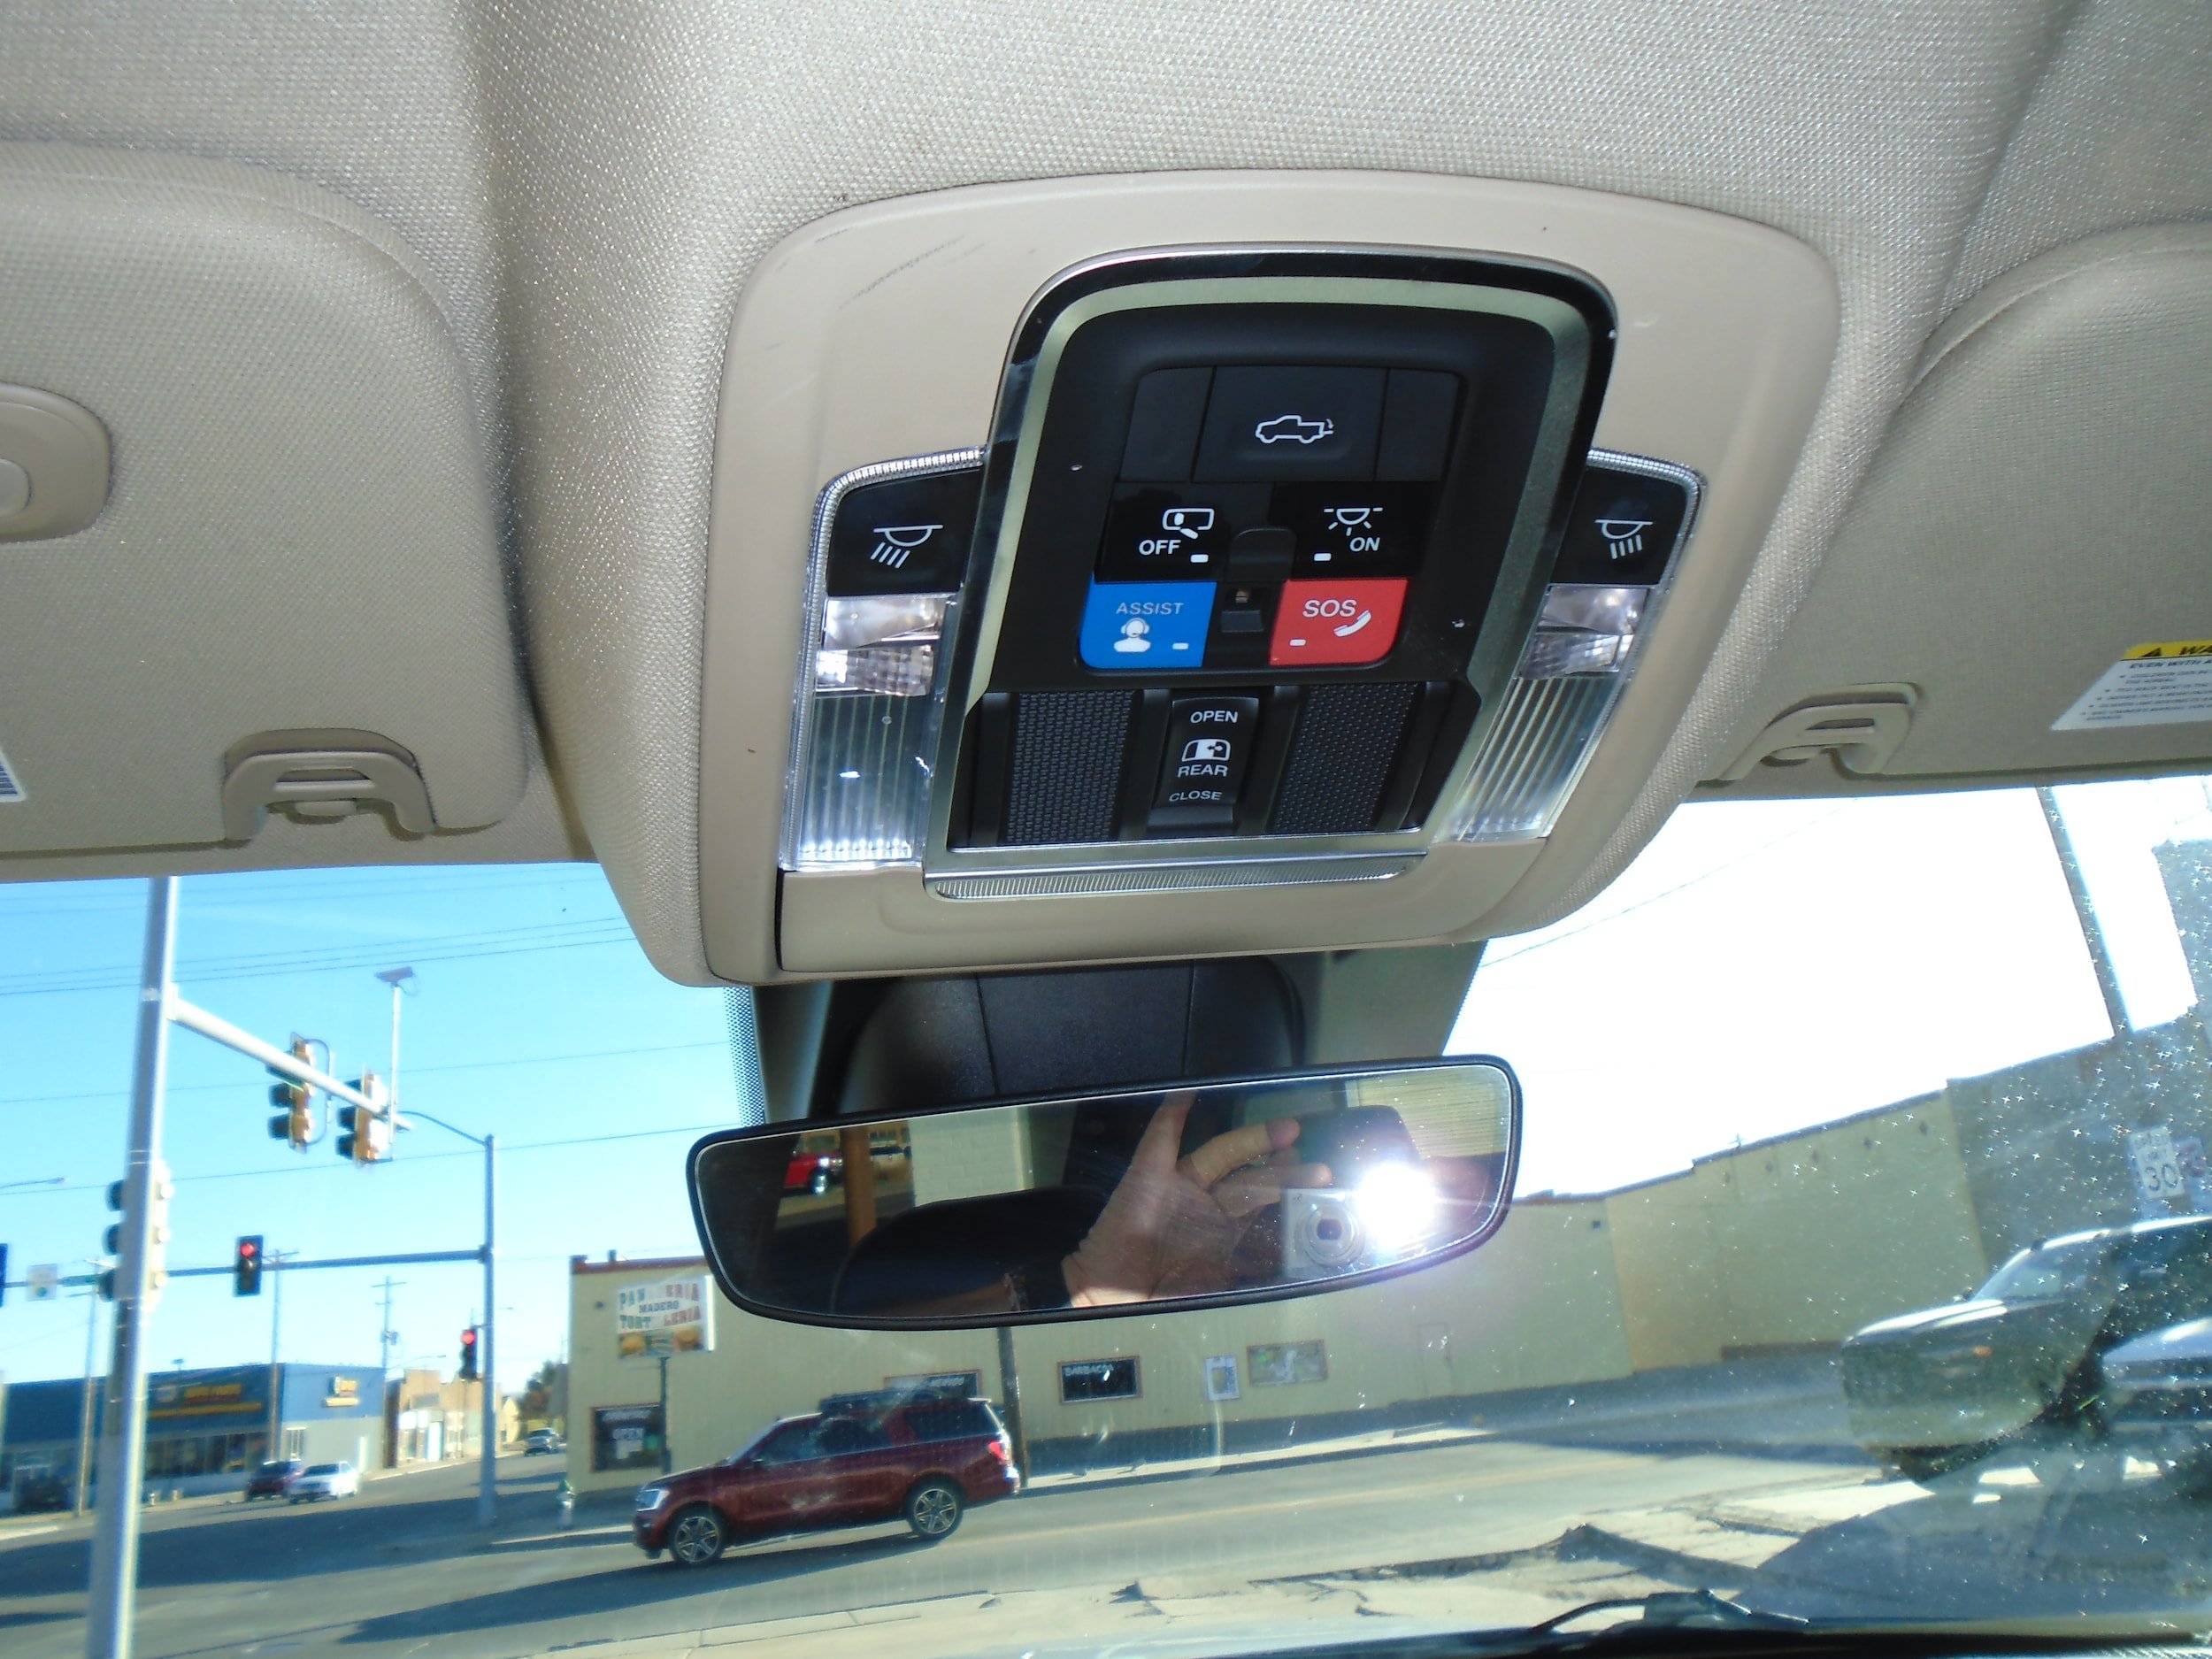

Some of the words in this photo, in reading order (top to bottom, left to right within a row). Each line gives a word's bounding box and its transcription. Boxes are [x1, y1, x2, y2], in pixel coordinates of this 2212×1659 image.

[1138, 539, 1181, 556] OFF
[1348, 536, 1380, 553] ON
[1115, 601, 1185, 616] ASSIST
[1302, 598, 1358, 618] SOS
[1189, 710, 1239, 724] OPEN
[1177, 764, 1229, 778] REAR
[1168, 789, 1223, 803] CLOSE
[2144, 1164, 2178, 1192] 30
[2145, 1164, 2177, 1191] MADERO
